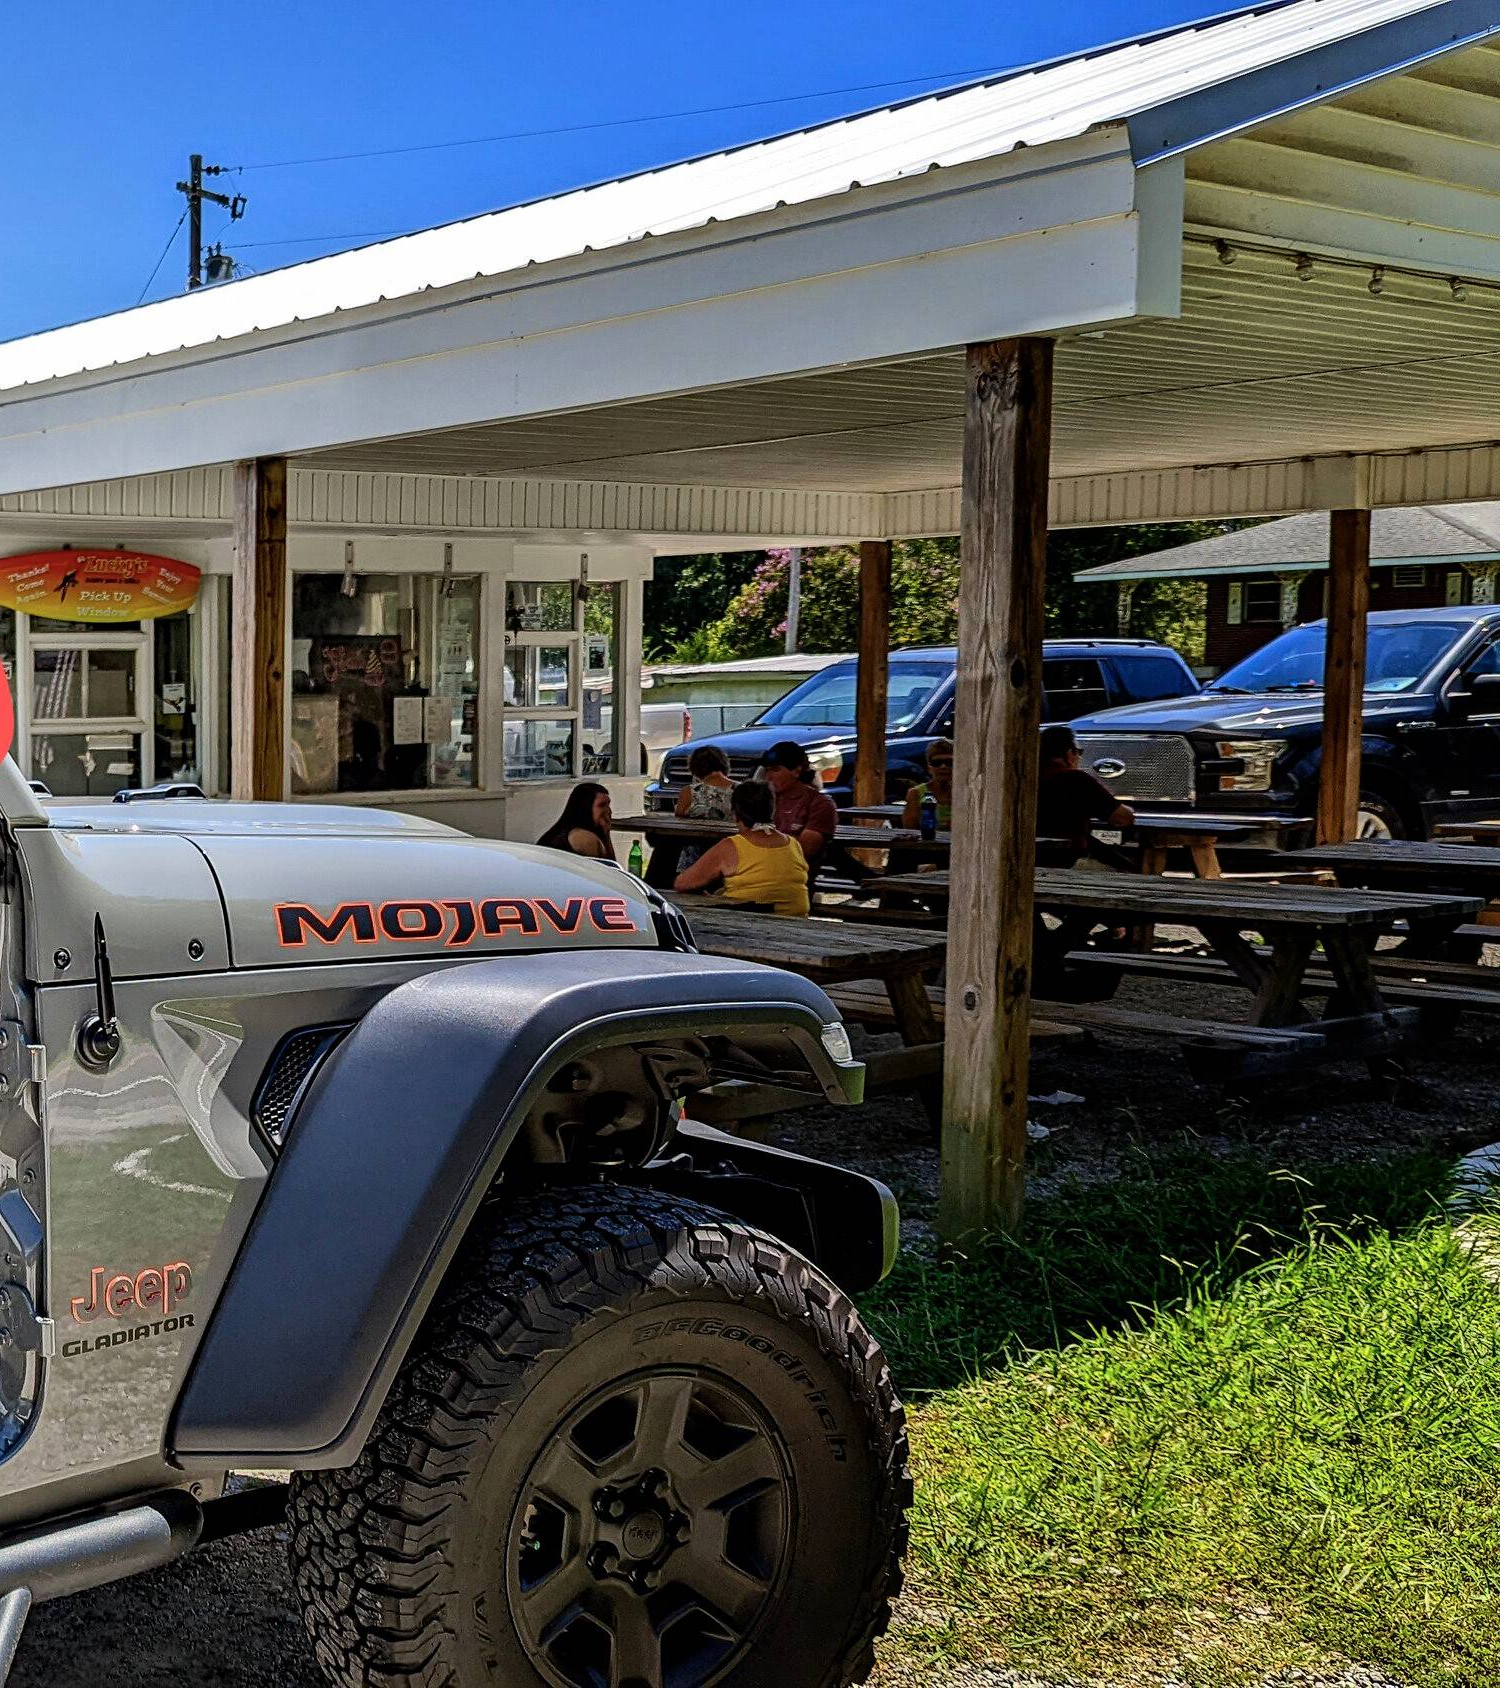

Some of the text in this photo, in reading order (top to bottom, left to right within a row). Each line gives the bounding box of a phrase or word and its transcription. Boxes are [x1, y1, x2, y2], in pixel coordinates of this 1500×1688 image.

[16, 578, 45, 592] Come
[83, 556, 150, 579] Lucky's
[79, 591, 133, 604] Pick Up
[273, 897, 640, 947] MOJAVE
[70, 1260, 193, 1325] Jeep
[62, 1313, 196, 1358] GLADIATOR
[632, 1317, 850, 1464] BFGoodrich
